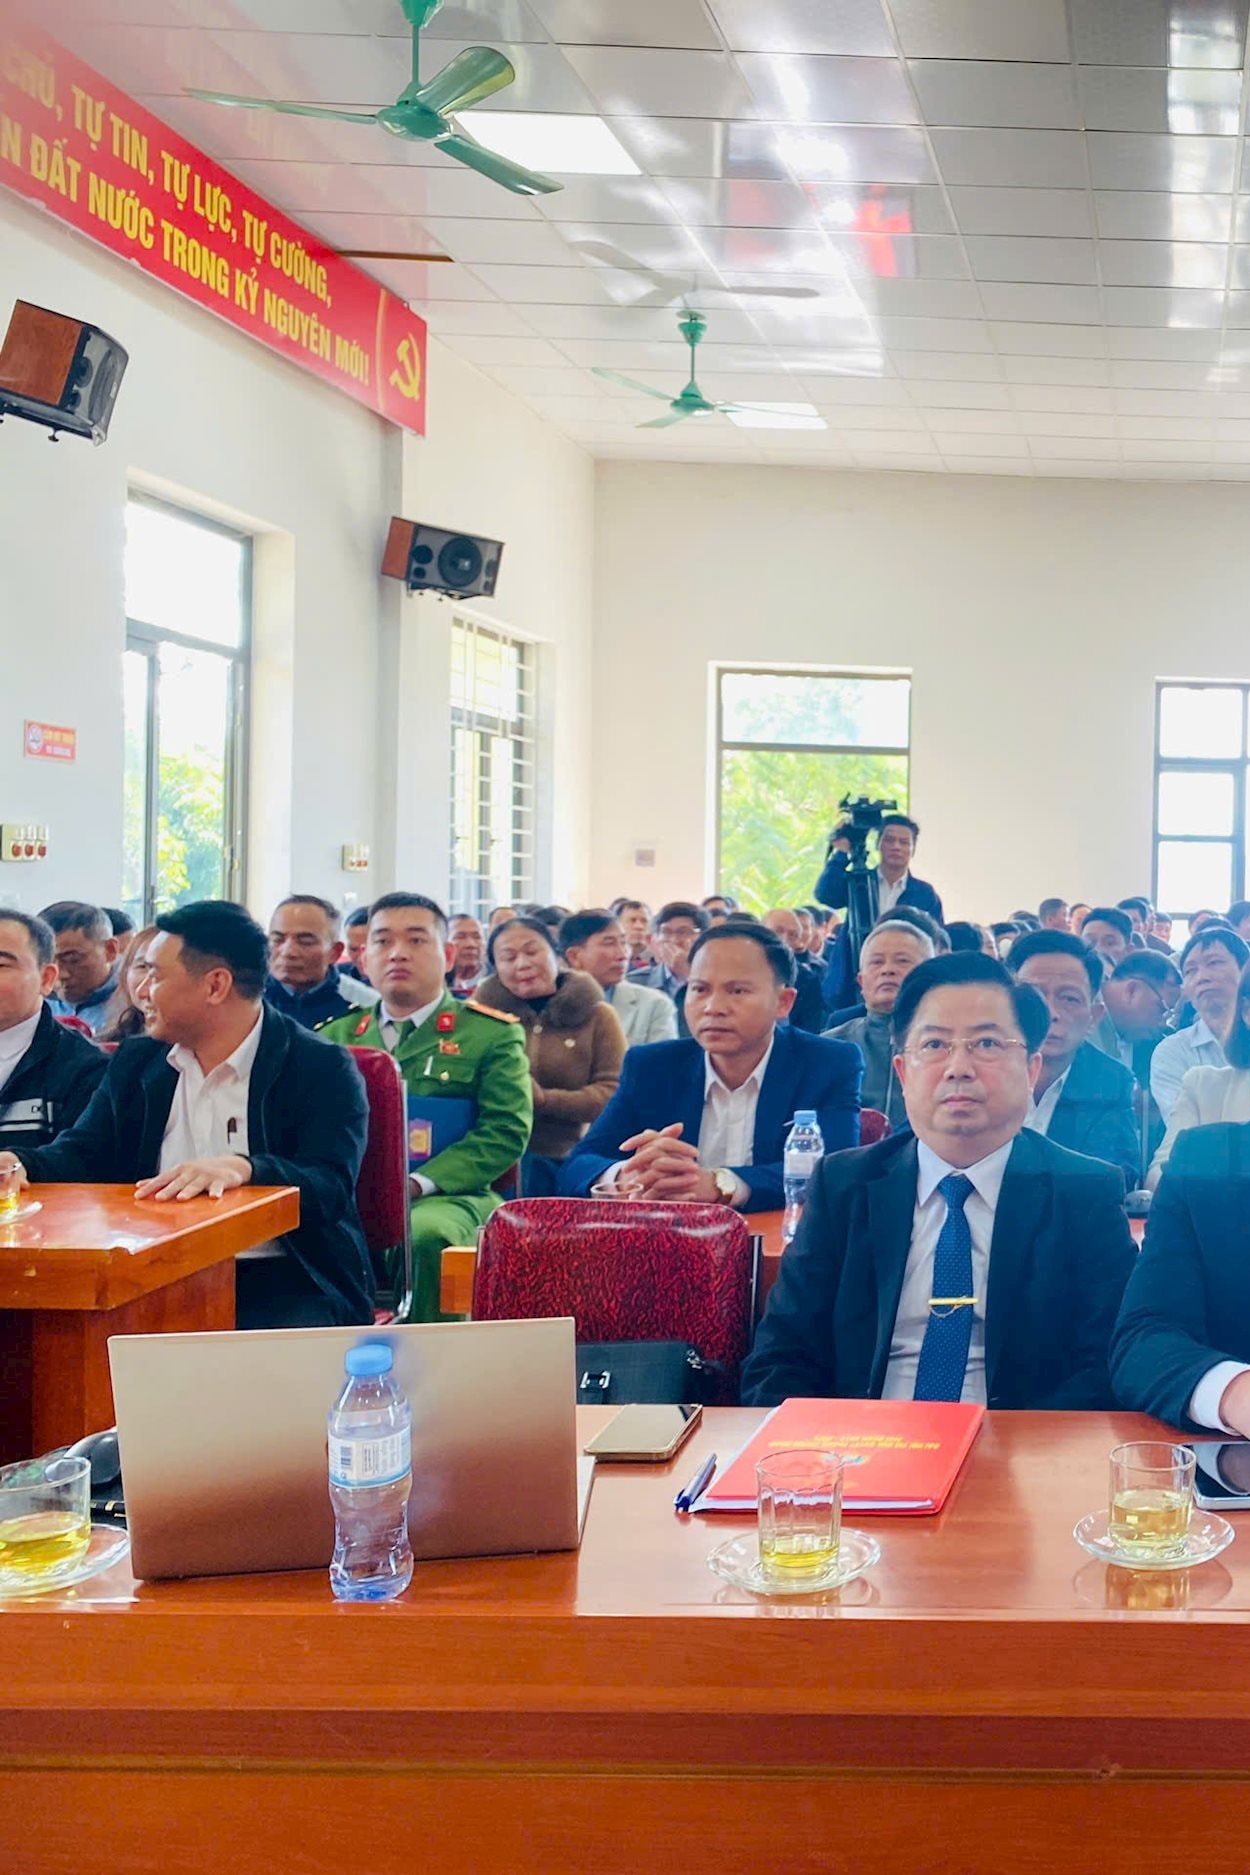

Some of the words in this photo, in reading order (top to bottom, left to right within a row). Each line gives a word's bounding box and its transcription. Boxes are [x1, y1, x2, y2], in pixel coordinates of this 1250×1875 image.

[30, 133, 81, 203] ĐẤT
[89, 171, 154, 249] NƯỚC
[161, 219, 230, 298] TRONG
[235, 267, 259, 315] KỶ
[264, 288, 331, 362] NGUYÊN
[335, 335, 369, 385] MỚI!
[71, 83, 105, 151] TỰ
[110, 112, 154, 185] TIN,
[161, 150, 190, 210] TỰ
[194, 174, 237, 243] LỰC,
[242, 209, 267, 264] TỰ
[270, 232, 332, 309] CƯỜNG,
